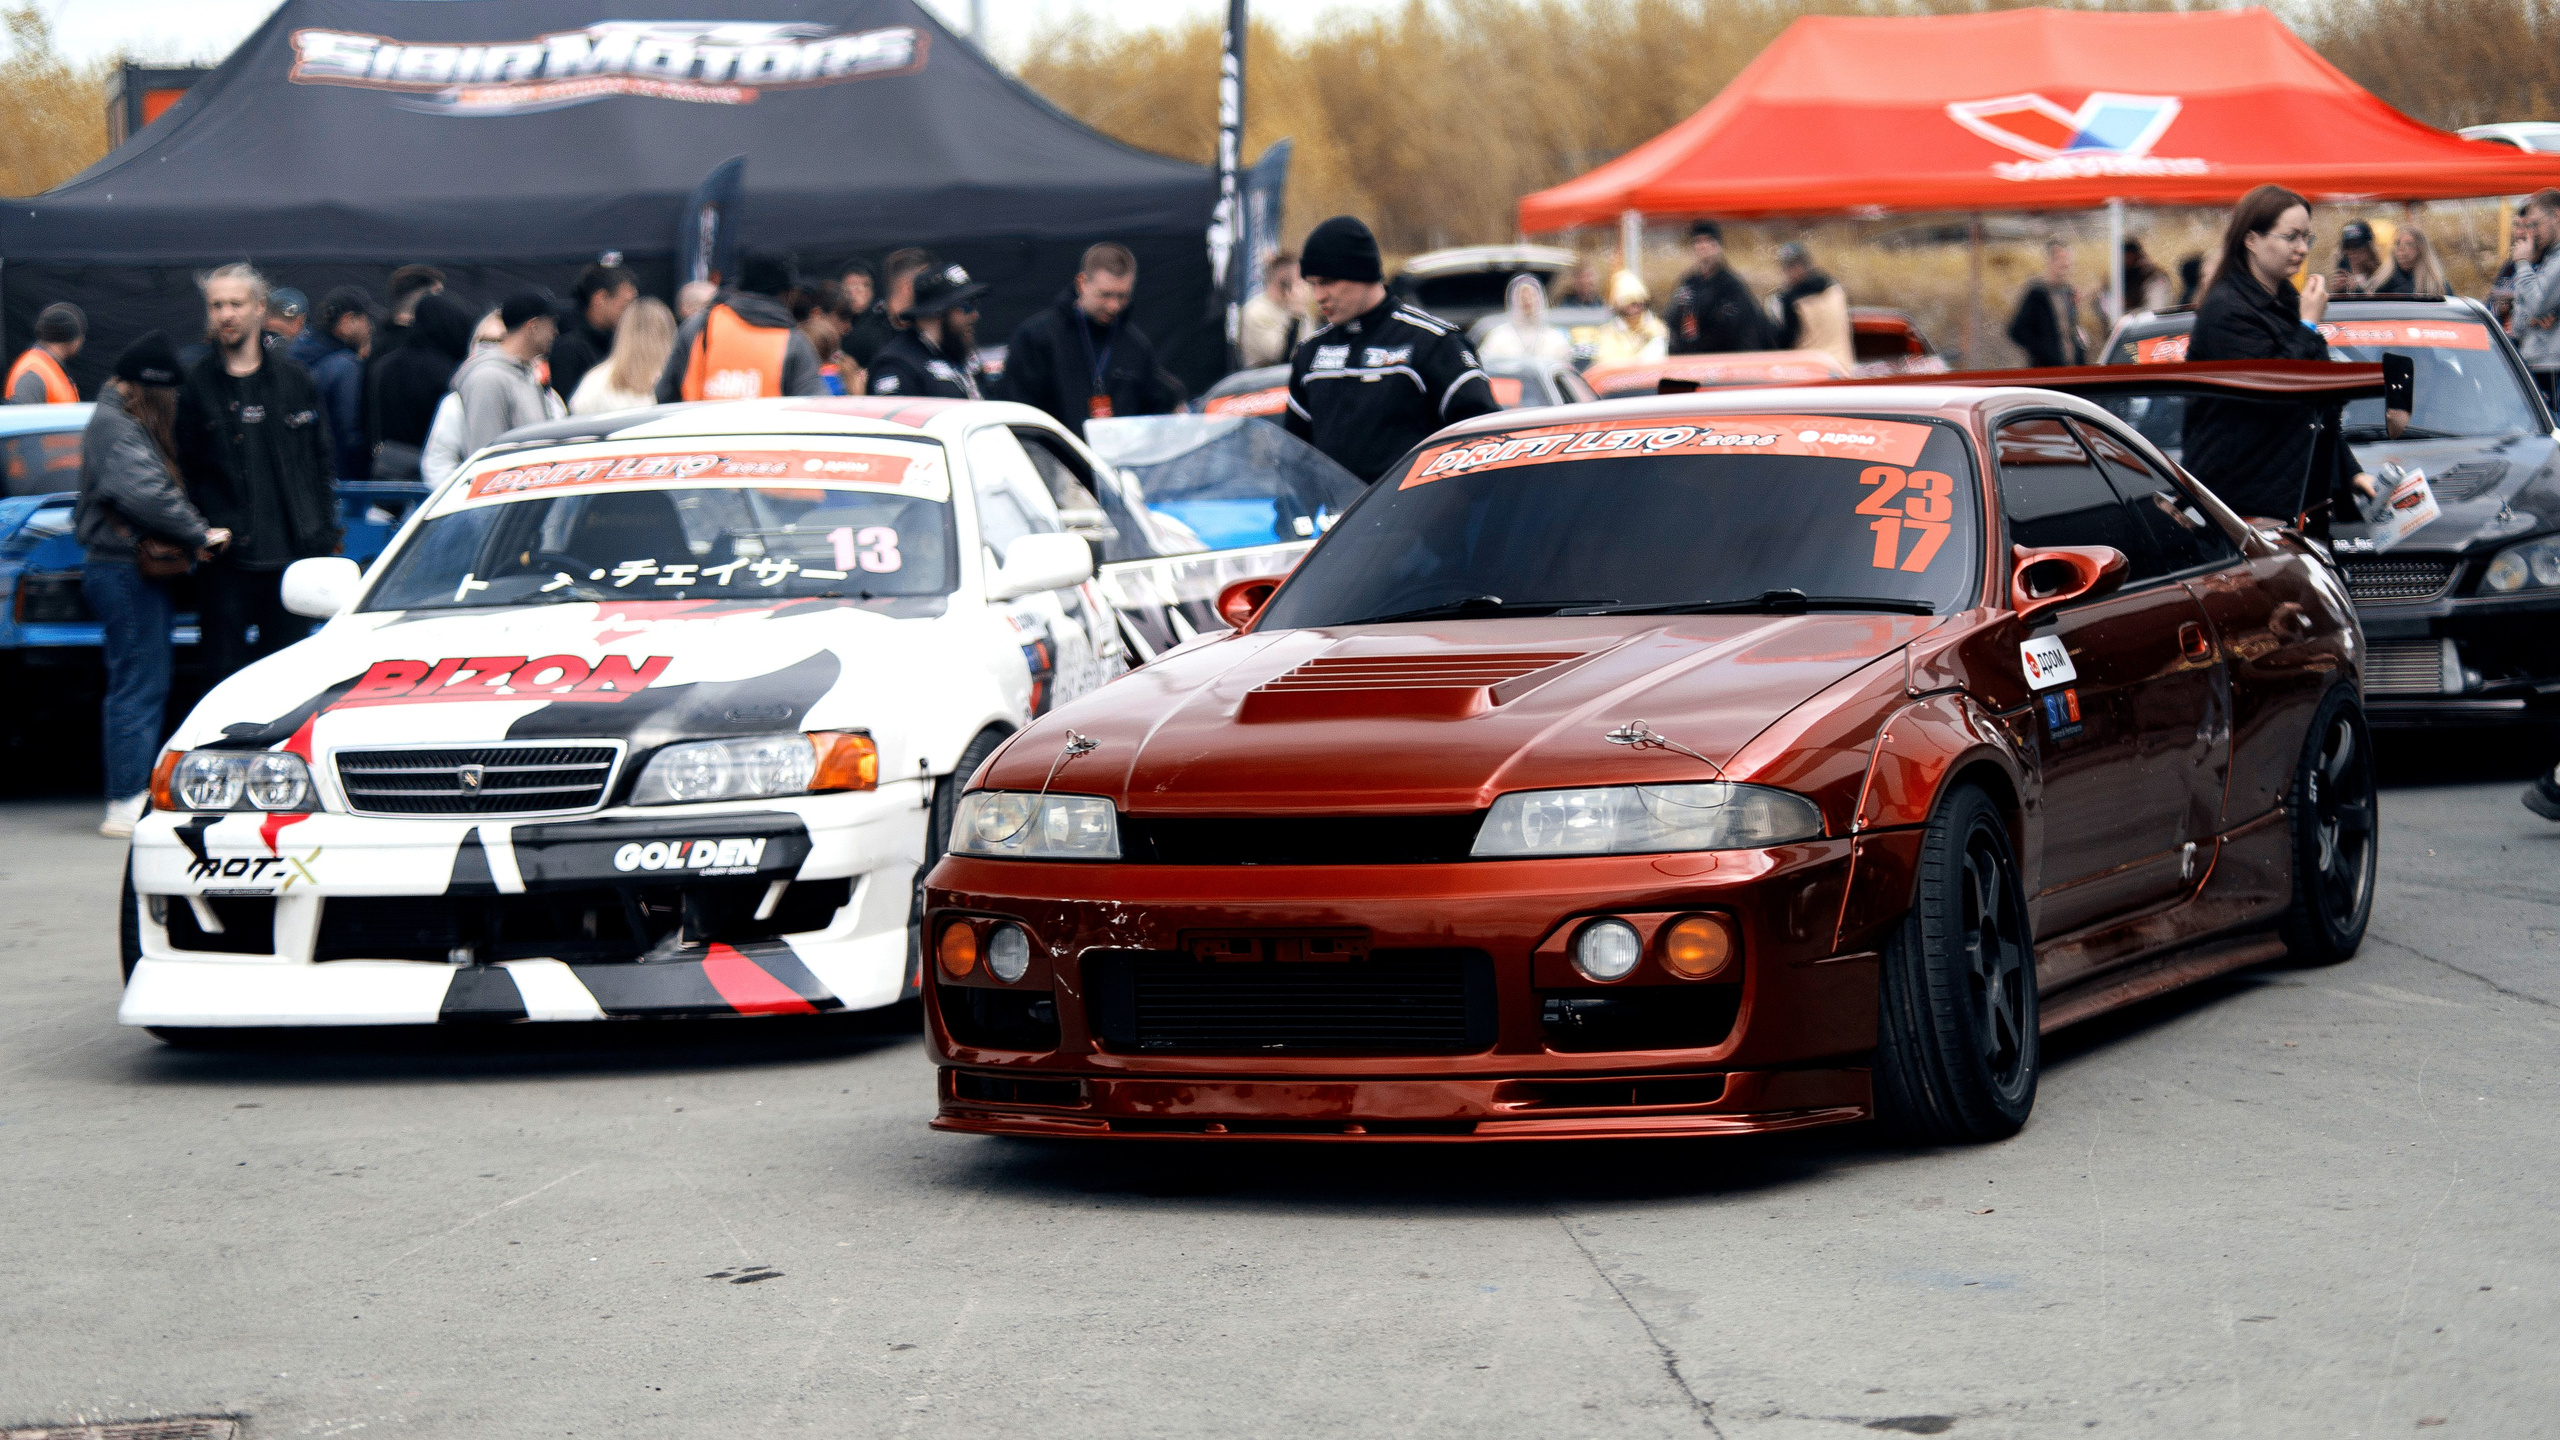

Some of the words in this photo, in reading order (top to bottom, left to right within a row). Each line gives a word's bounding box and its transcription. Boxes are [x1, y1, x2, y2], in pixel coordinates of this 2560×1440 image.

[1420, 433, 1577, 477] DRIFT
[1562, 426, 1698, 454] LETO
[1699, 433, 1780, 447] 2026
[1820, 430, 1876, 446] дром
[479, 459, 616, 494] DRIFT
[604, 454, 718, 480] LETO
[1854, 466, 1954, 522] 23
[826, 526, 903, 573] 13
[1869, 516, 1952, 573] 17
[338, 654, 674, 697] BIZON
[2037, 648, 2067, 678] дром
